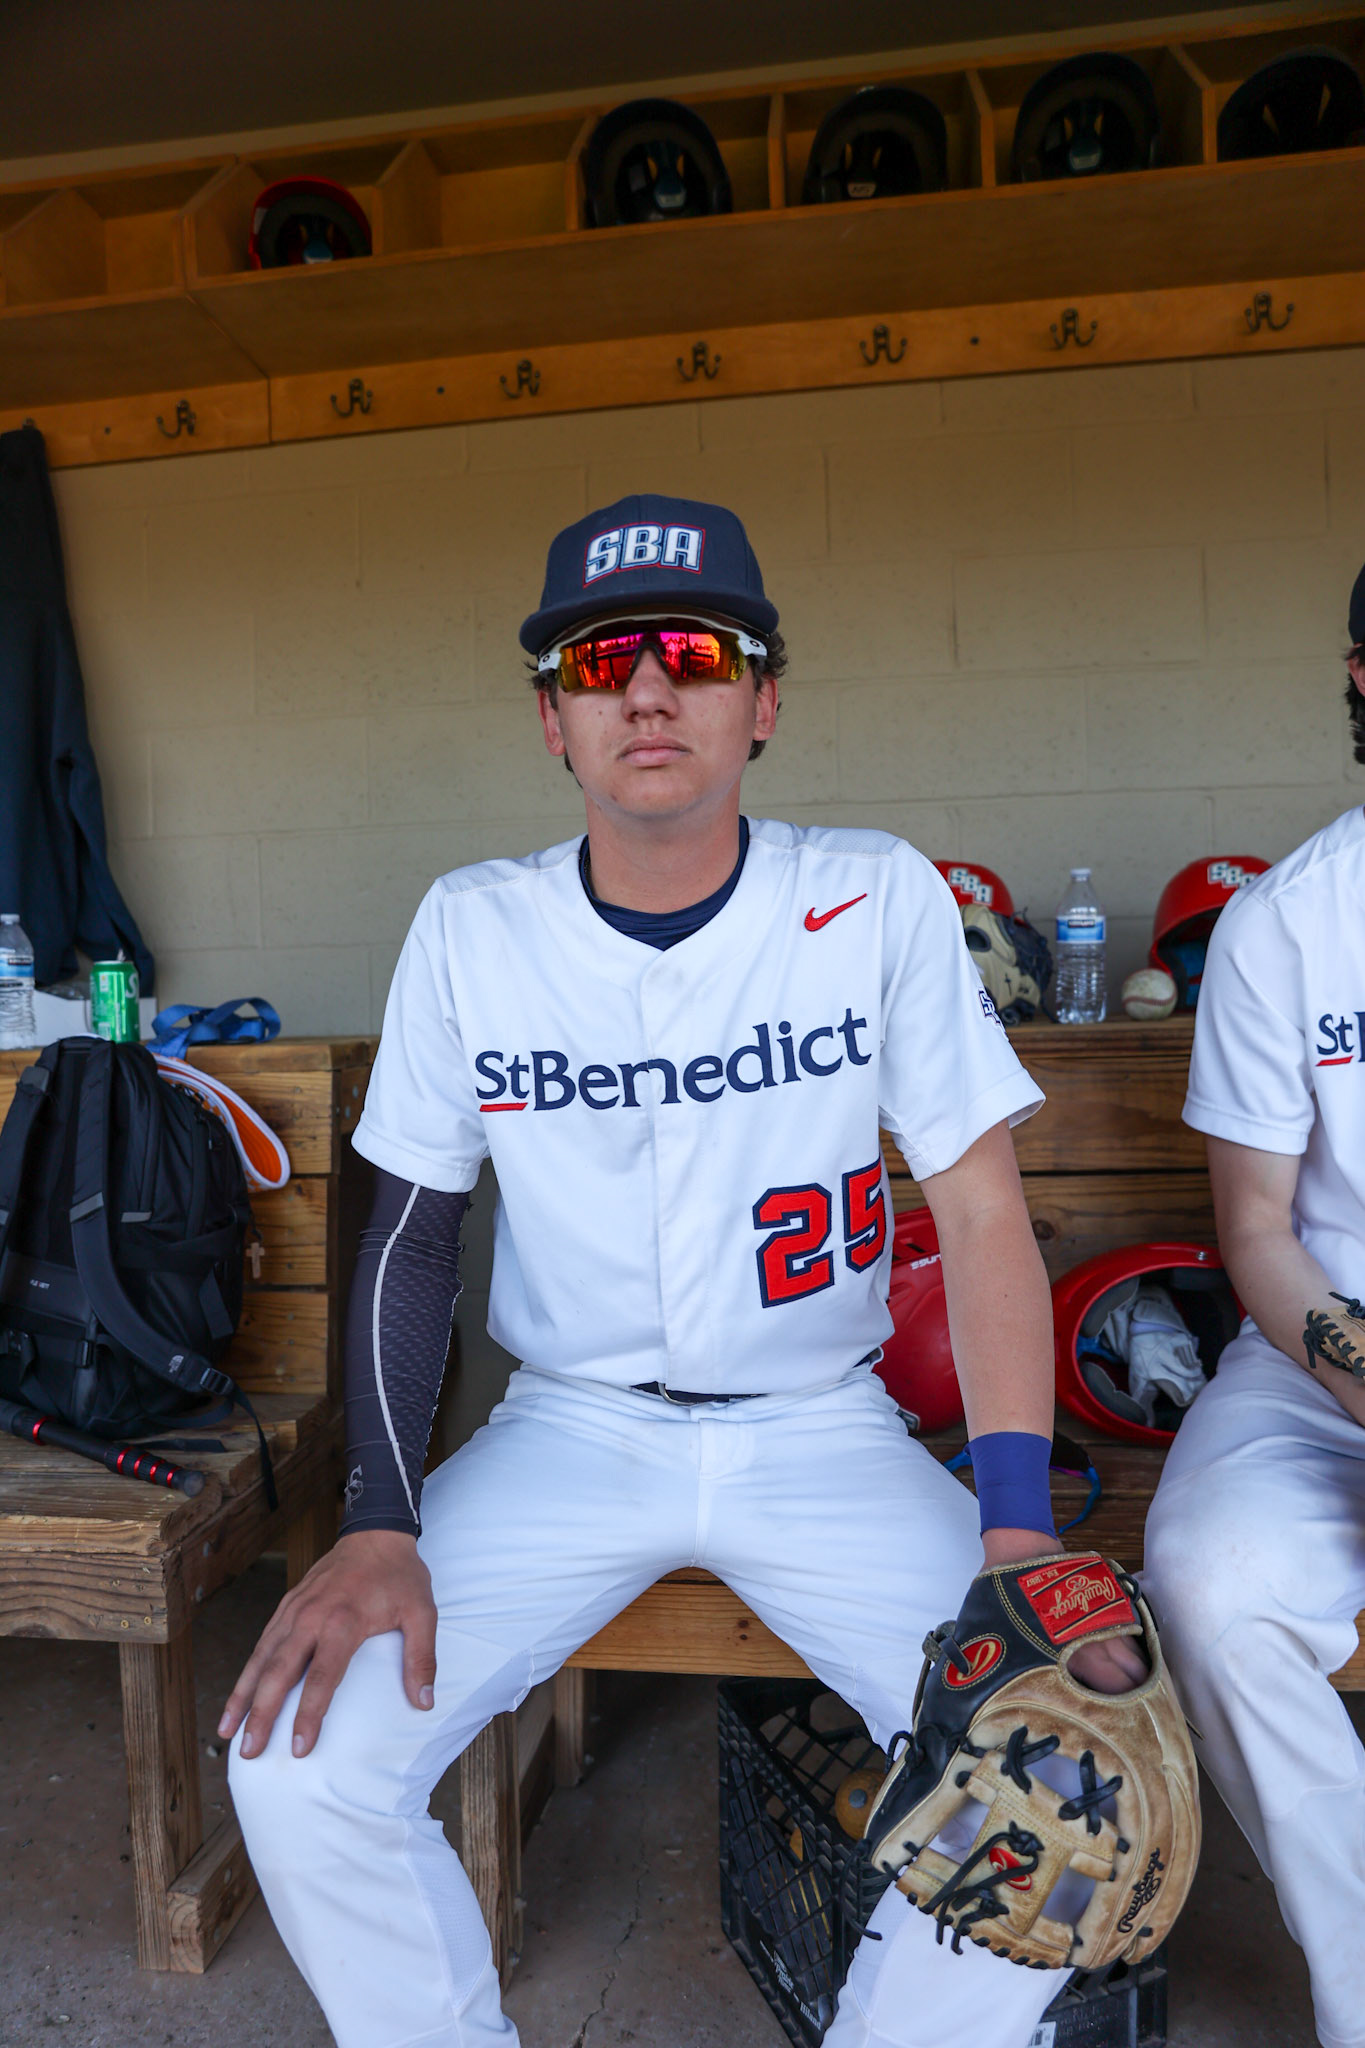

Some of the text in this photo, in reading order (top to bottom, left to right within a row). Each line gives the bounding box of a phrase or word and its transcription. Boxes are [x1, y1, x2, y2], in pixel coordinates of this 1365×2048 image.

[584, 522, 706, 588] SBA
[949, 867, 993, 906] SBA
[752, 1156, 887, 1309] 25
[1050, 1576, 1116, 1619] Rawlings
[1117, 1847, 1165, 1933] Rawlings
